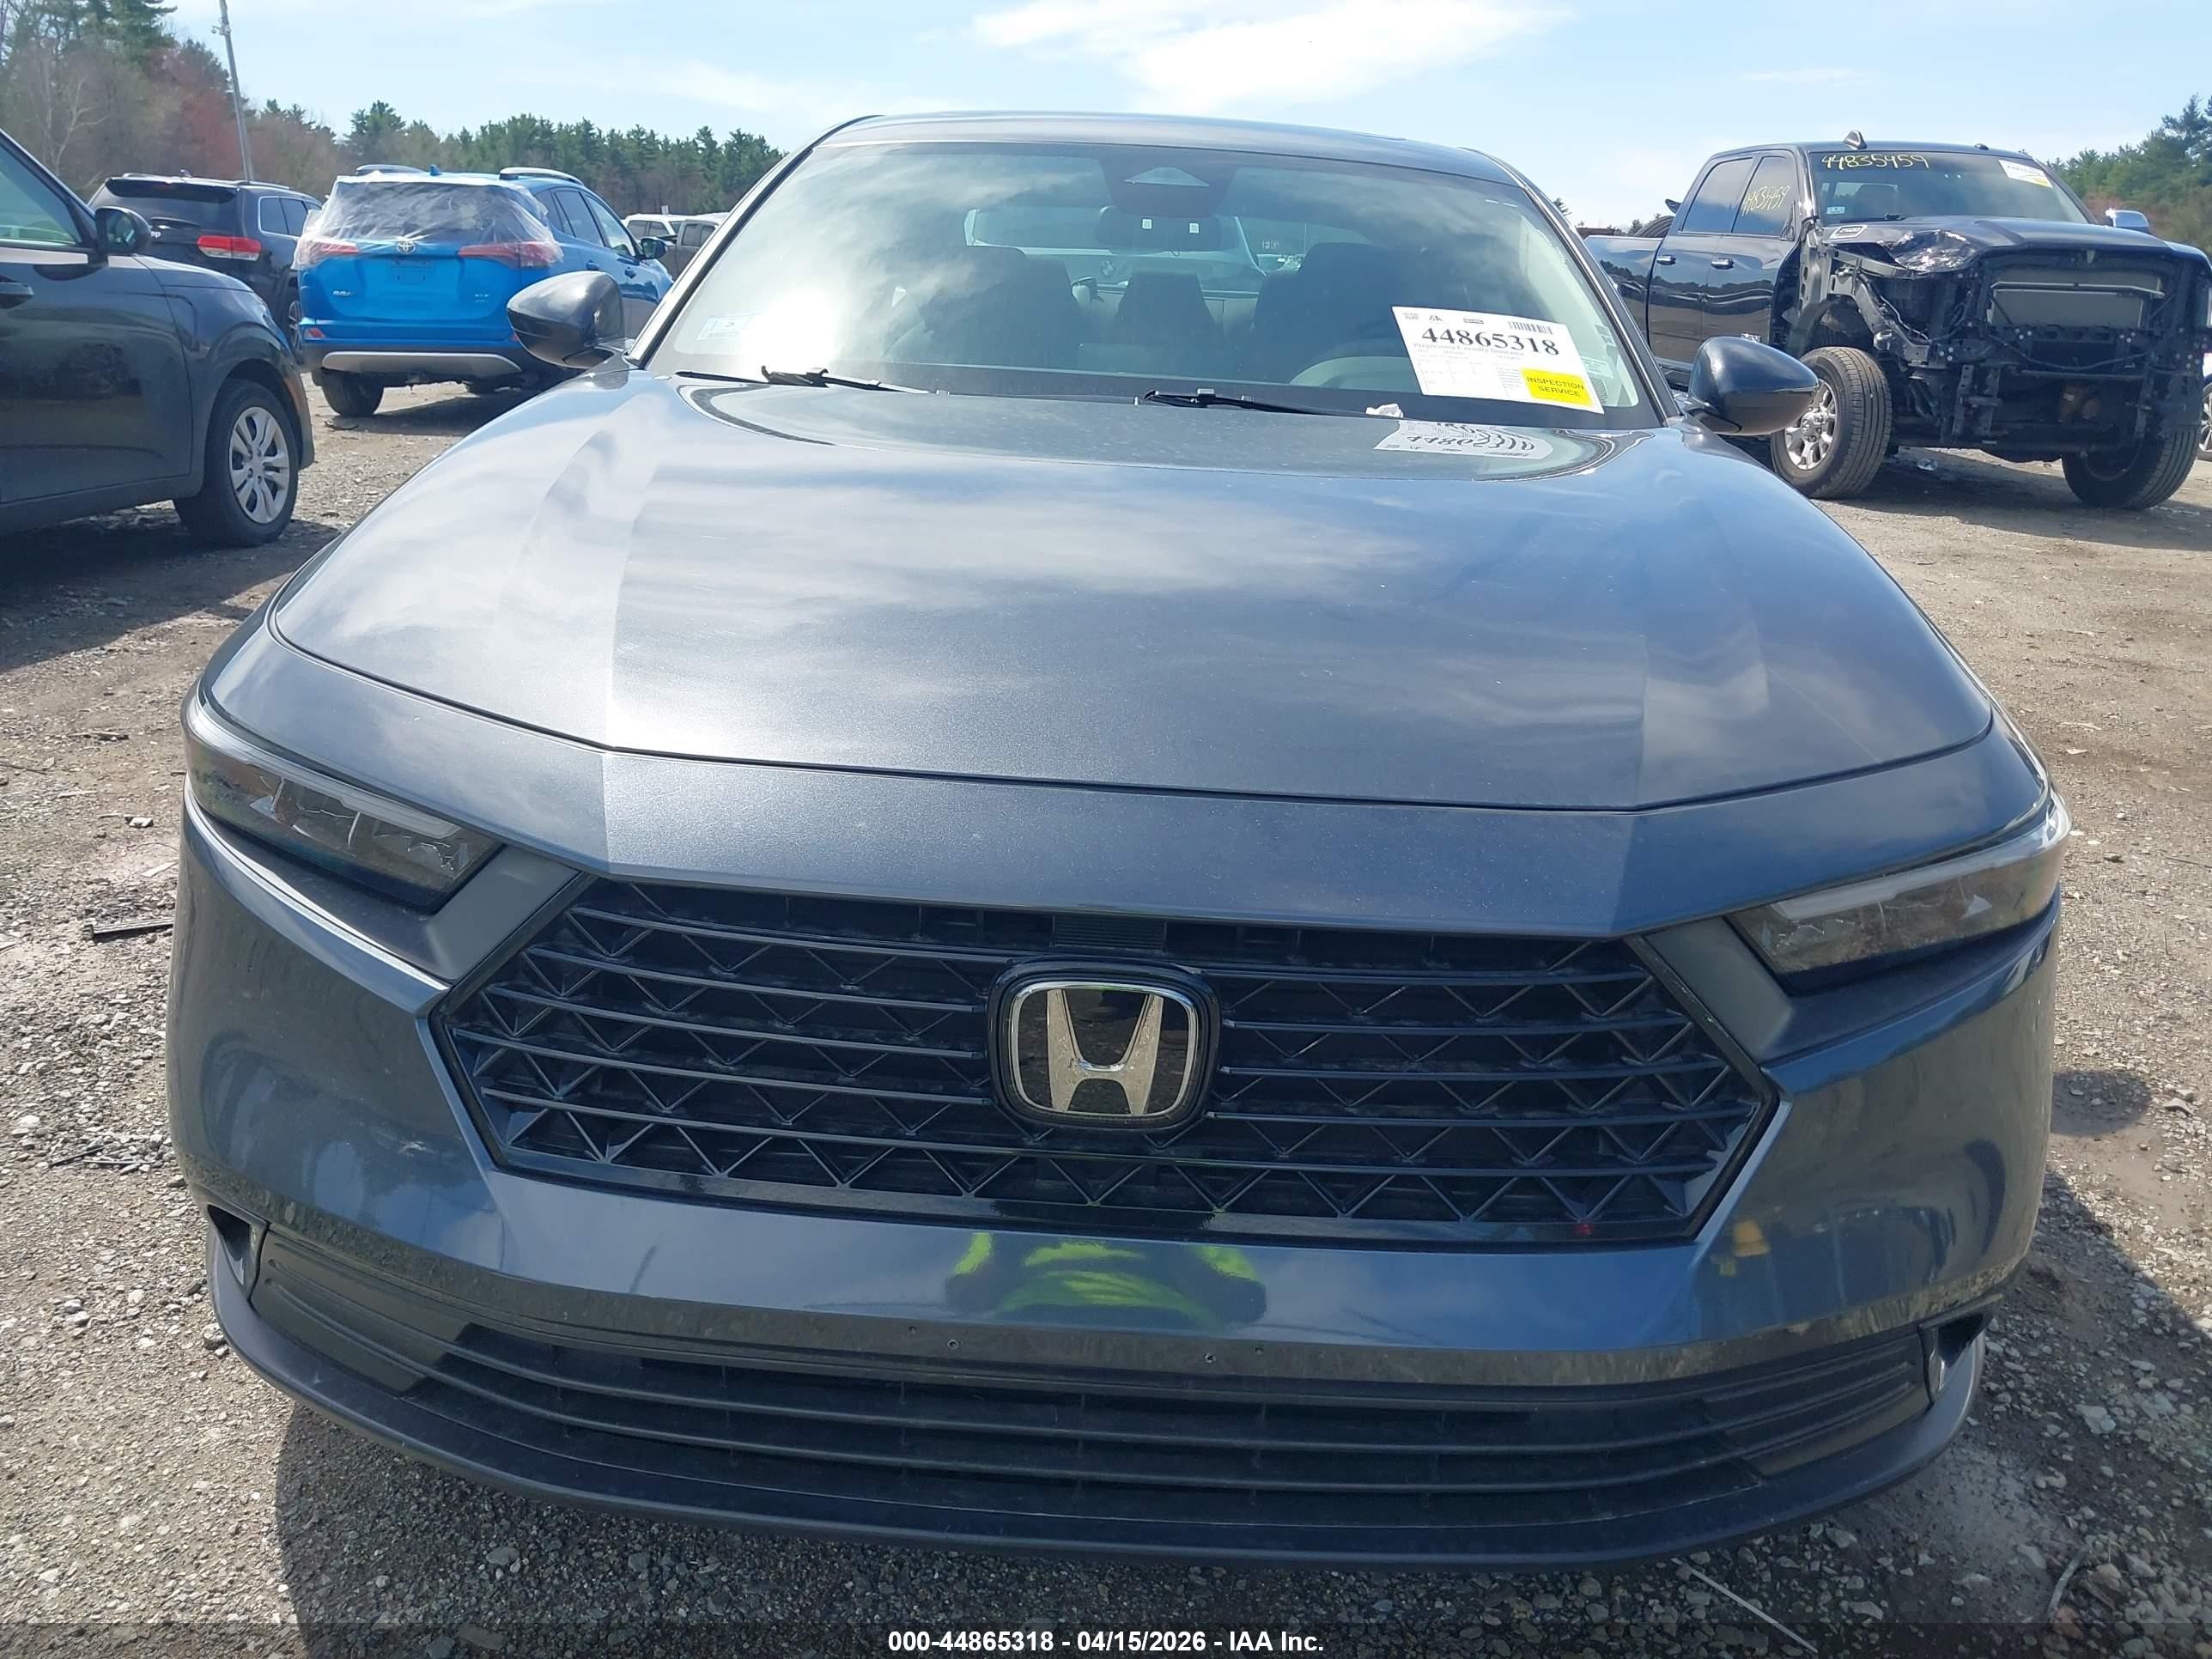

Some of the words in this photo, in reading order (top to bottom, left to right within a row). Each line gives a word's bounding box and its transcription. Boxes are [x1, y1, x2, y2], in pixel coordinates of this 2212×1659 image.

[1820, 154, 1929, 170] 44835459
[1421, 327, 1559, 356] 44865318
[1526, 378, 1584, 390] INSPECTION
[1538, 386, 1581, 397] SERVICE
